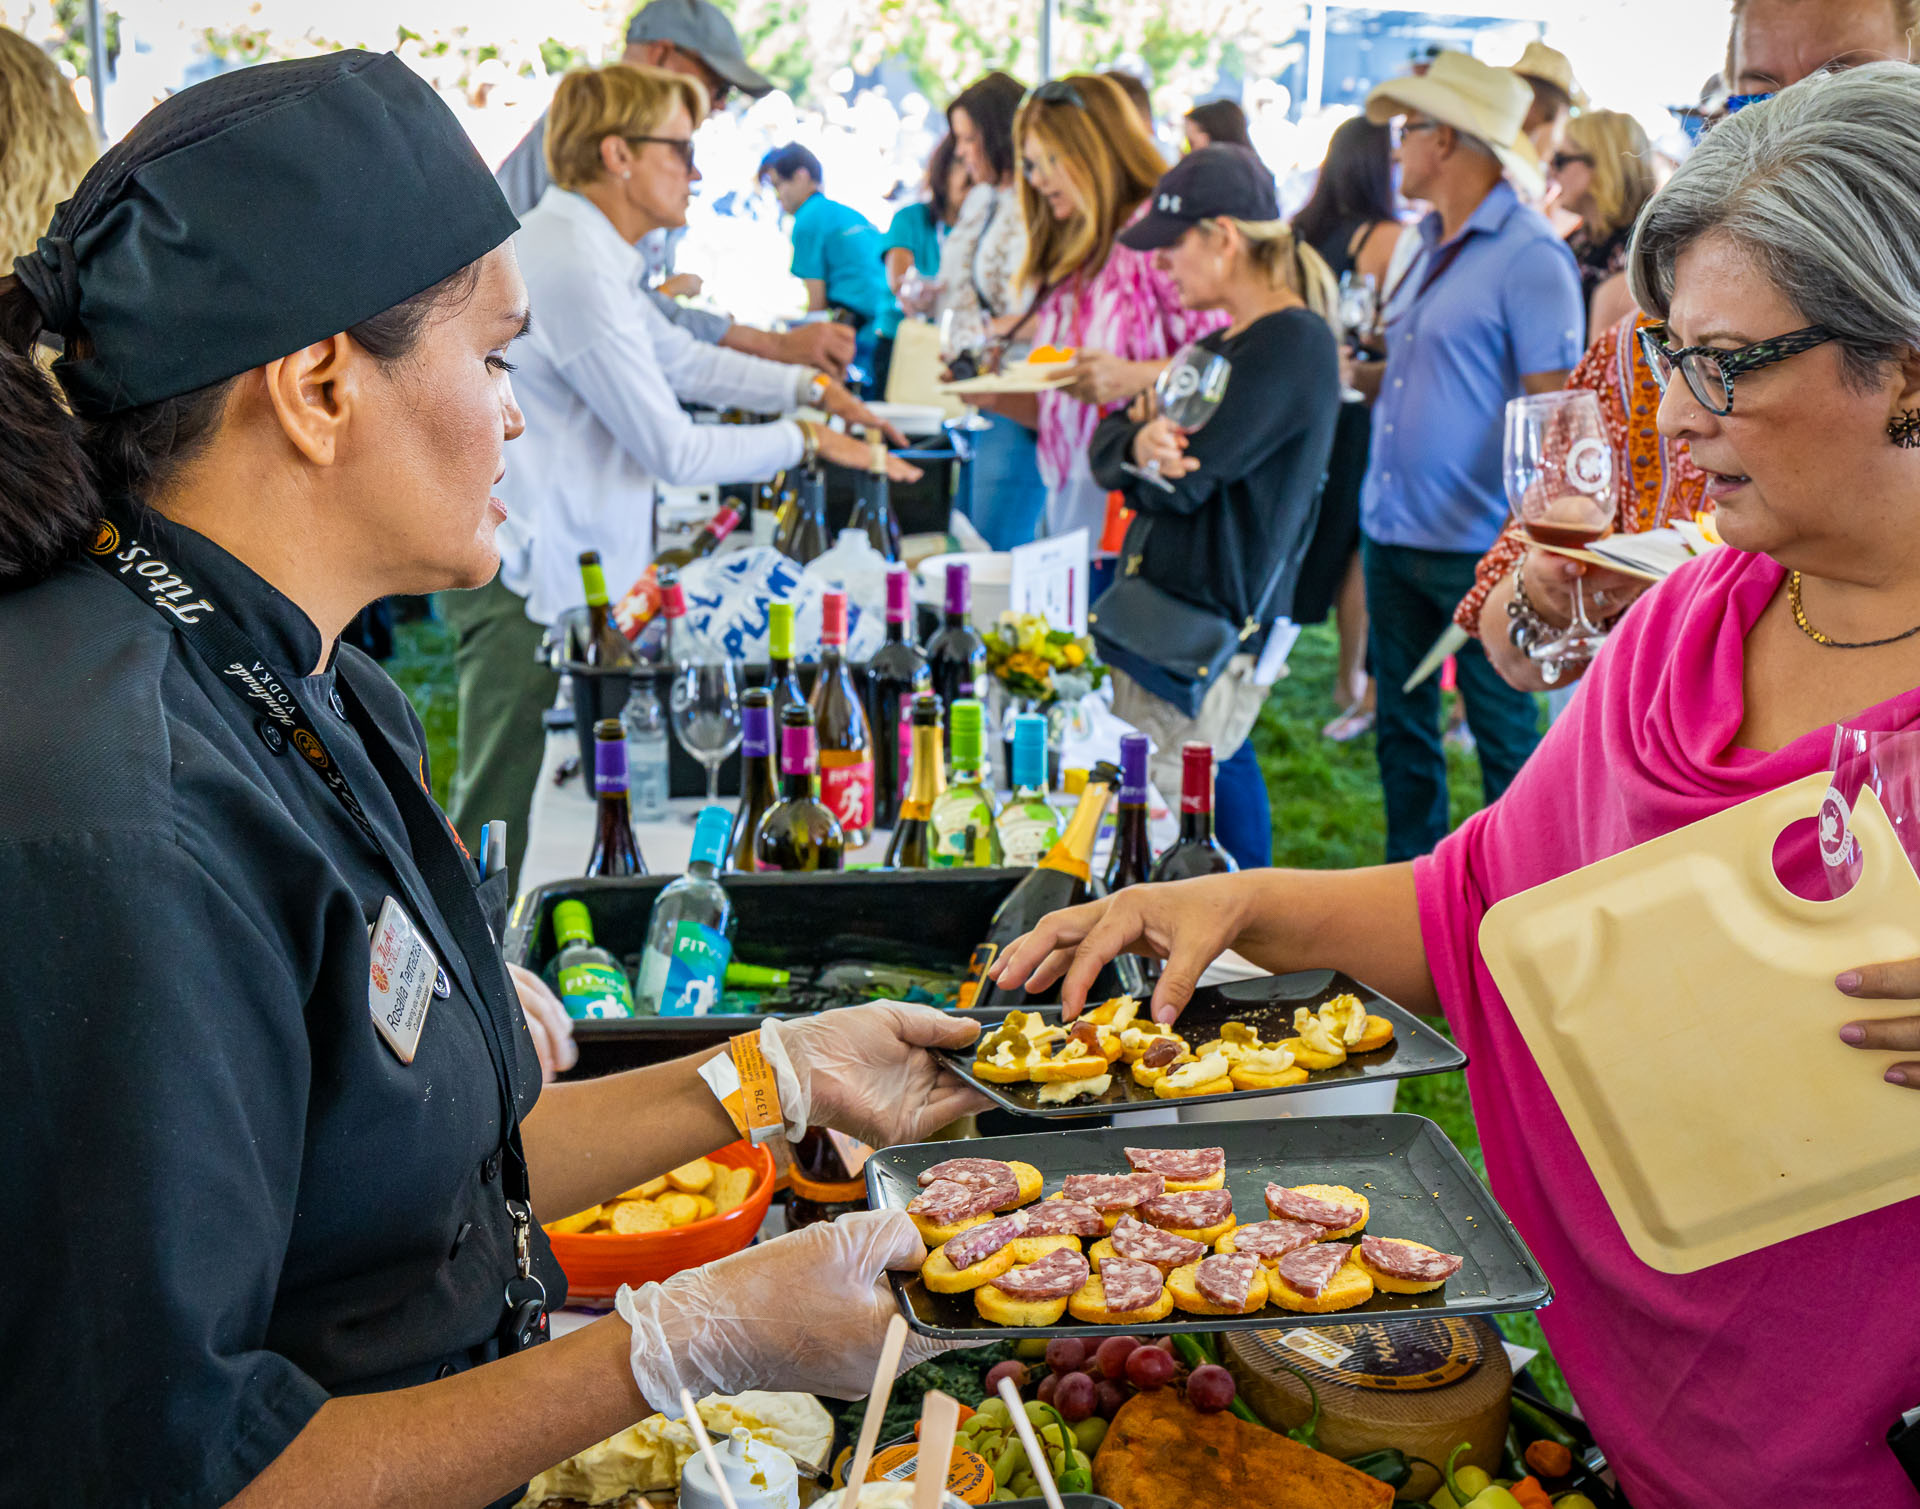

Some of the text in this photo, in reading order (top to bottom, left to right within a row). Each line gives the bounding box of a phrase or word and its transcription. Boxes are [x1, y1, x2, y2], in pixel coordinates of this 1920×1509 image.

[224, 663, 296, 726] Handmade
[252, 661, 296, 714] VODKA
[387, 942, 422, 1033] Rosalia Terrazas
[754, 1088, 769, 1118] 1378
[964, 1463, 986, 1492] SPREAD
